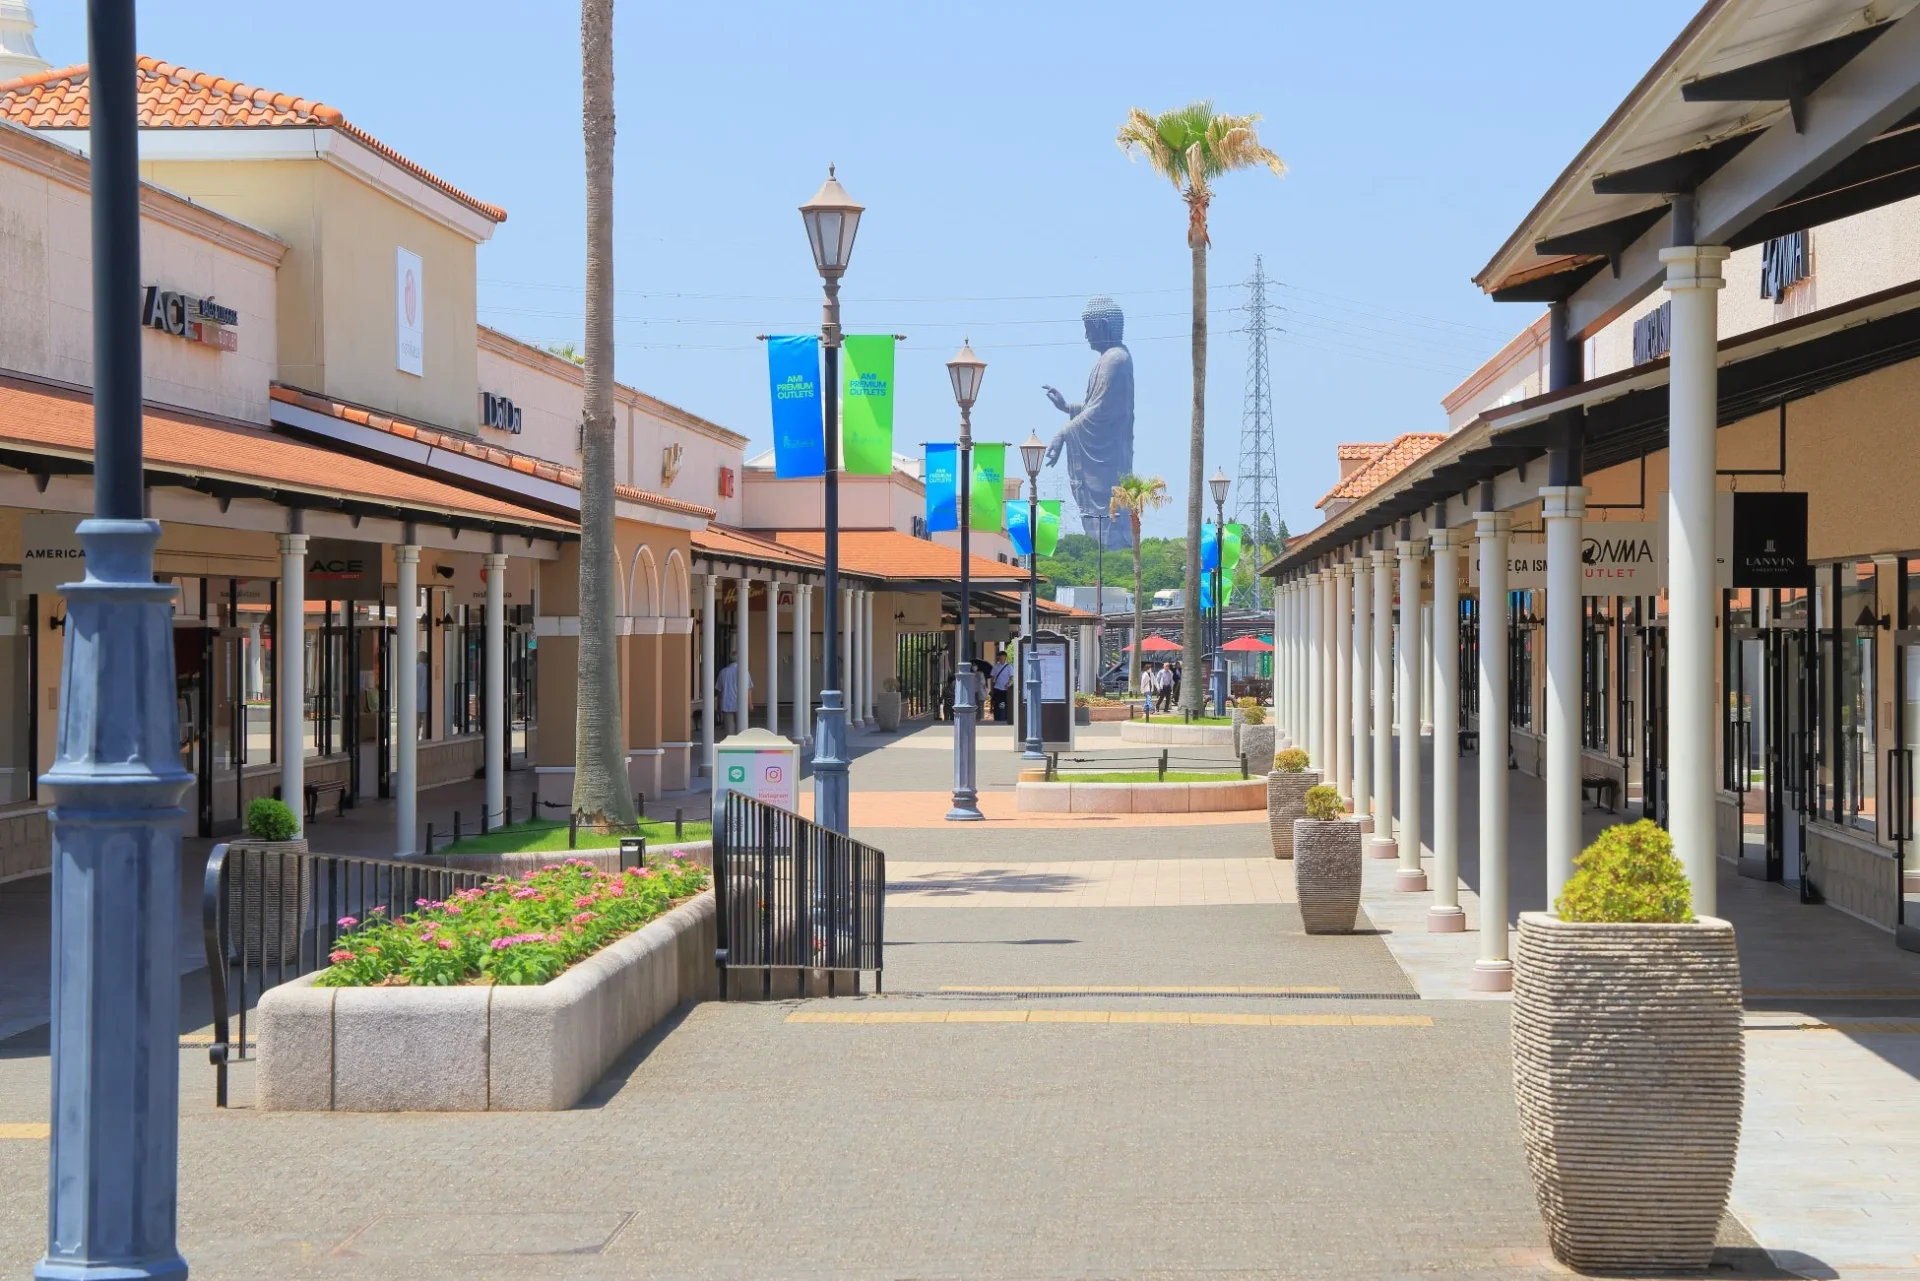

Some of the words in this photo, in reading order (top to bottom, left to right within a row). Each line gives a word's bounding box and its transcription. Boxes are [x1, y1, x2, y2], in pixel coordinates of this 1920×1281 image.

[142, 285, 200, 341] ACE
[788, 374, 803, 383] AMI
[777, 382, 814, 392] PREMIUM
[850, 381, 886, 389] PREMIUM
[778, 390, 814, 400] OUTLETS
[850, 388, 886, 396] OUTLETS
[25, 549, 87, 559] AMERICA
[1582, 538, 1654, 566] ONMA
[309, 560, 364, 573] ACE
[1746, 557, 1795, 566] LANVIN
[1585, 569, 1636, 578] UTLET
